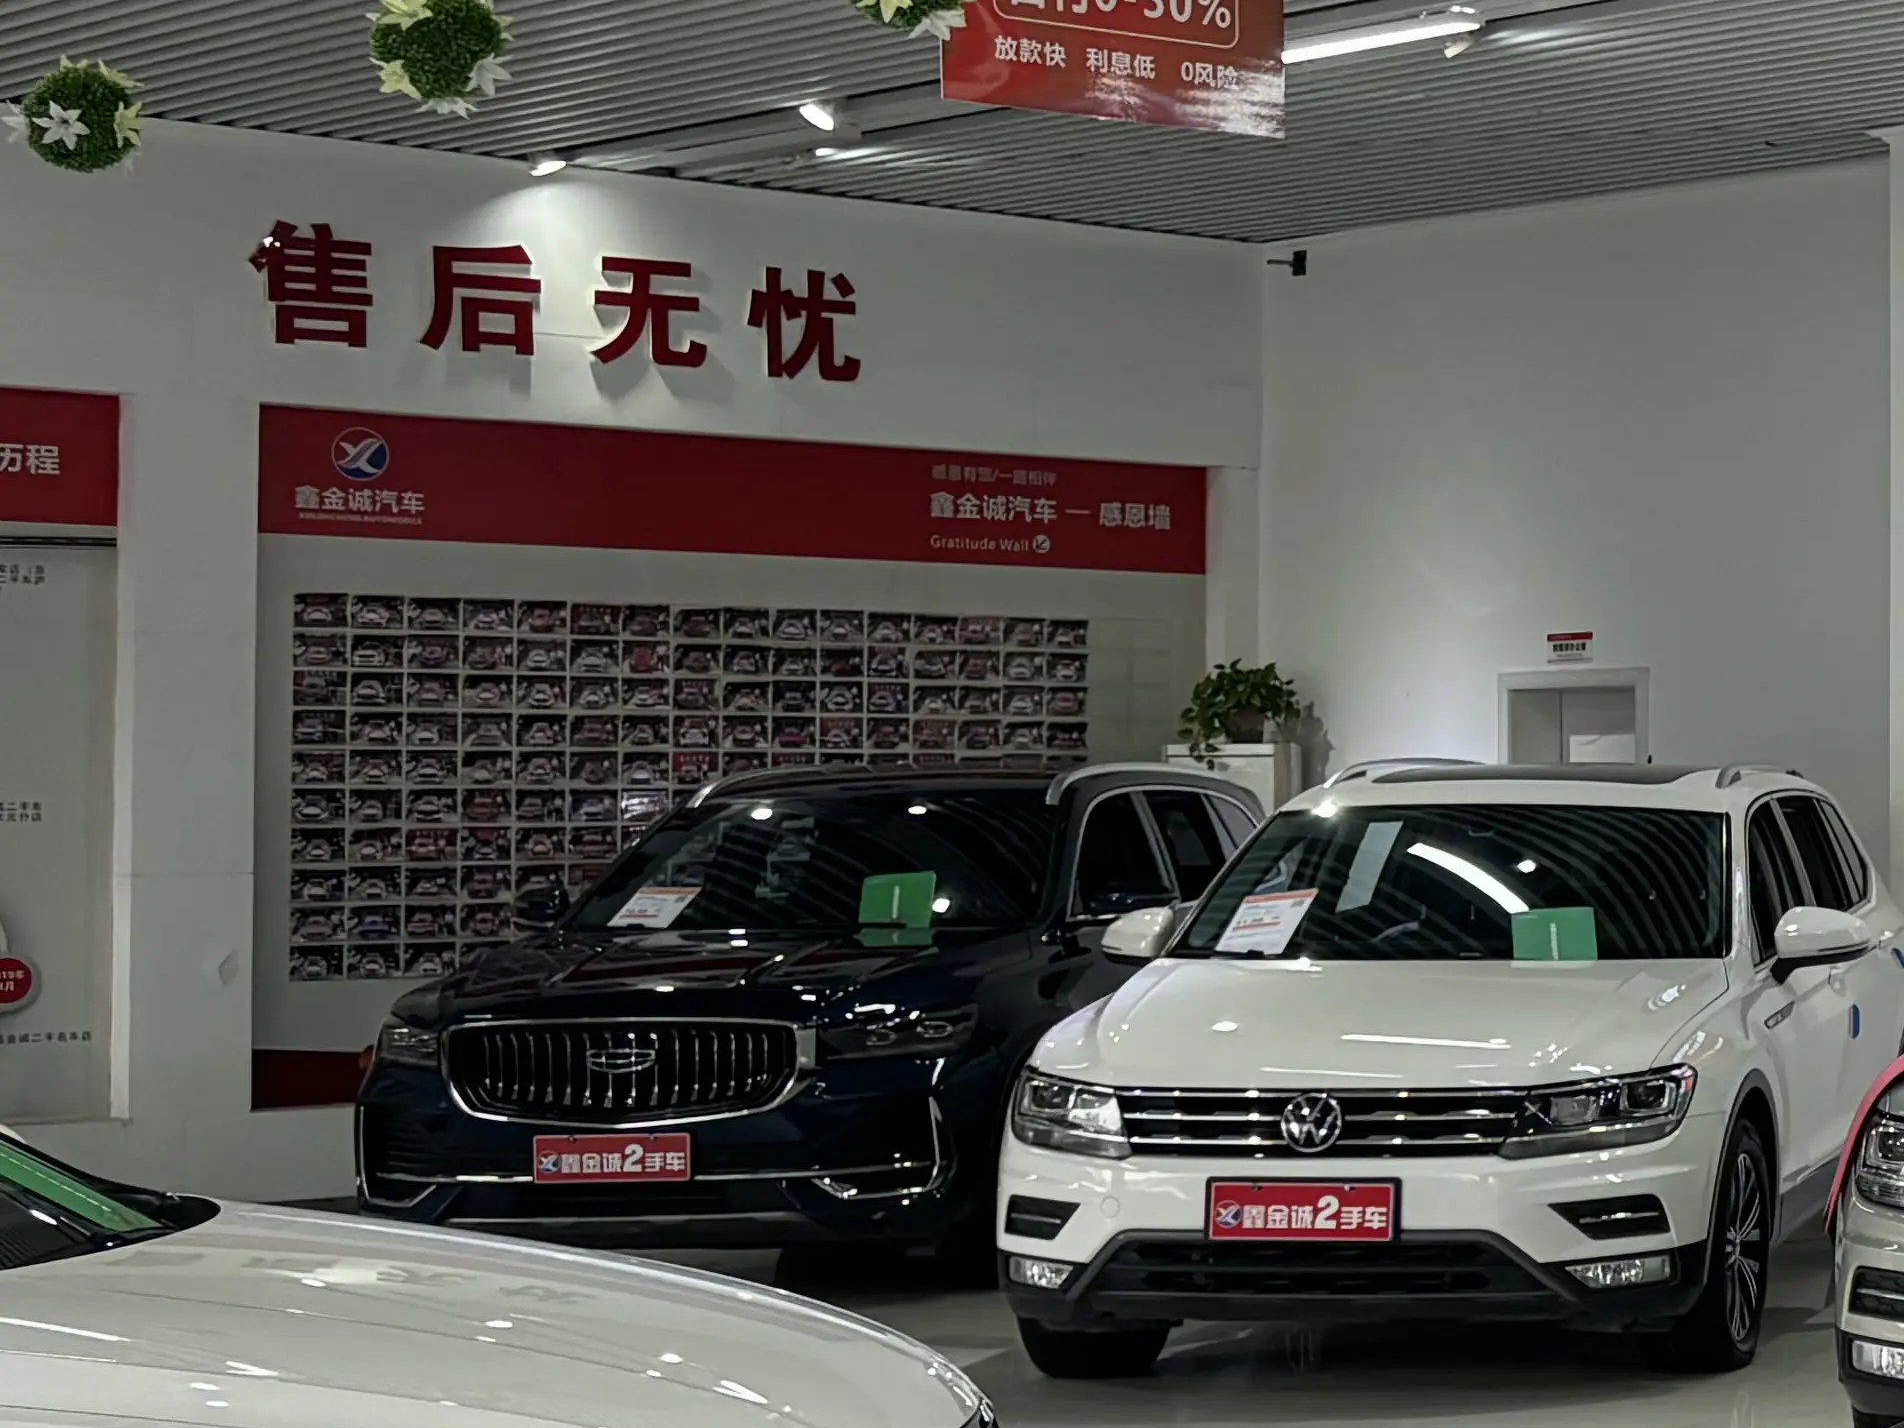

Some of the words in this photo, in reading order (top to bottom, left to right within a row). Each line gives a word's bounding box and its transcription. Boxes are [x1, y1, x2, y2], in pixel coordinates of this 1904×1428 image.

[994, 35, 1067, 69] 放款快
[1086, 47, 1156, 80] 利息低
[249, 220, 861, 383] 售后无忧
[294, 485, 426, 514] 鑫金诚汽车
[929, 491, 1058, 524] 鑫金诚汽车
[1099, 501, 1172, 531] 感恩墙
[930, 534, 997, 551] Gratitude
[1000, 538, 1030, 553] Wall
[1241, 1194, 1388, 1230] 鑫金诚2手车
